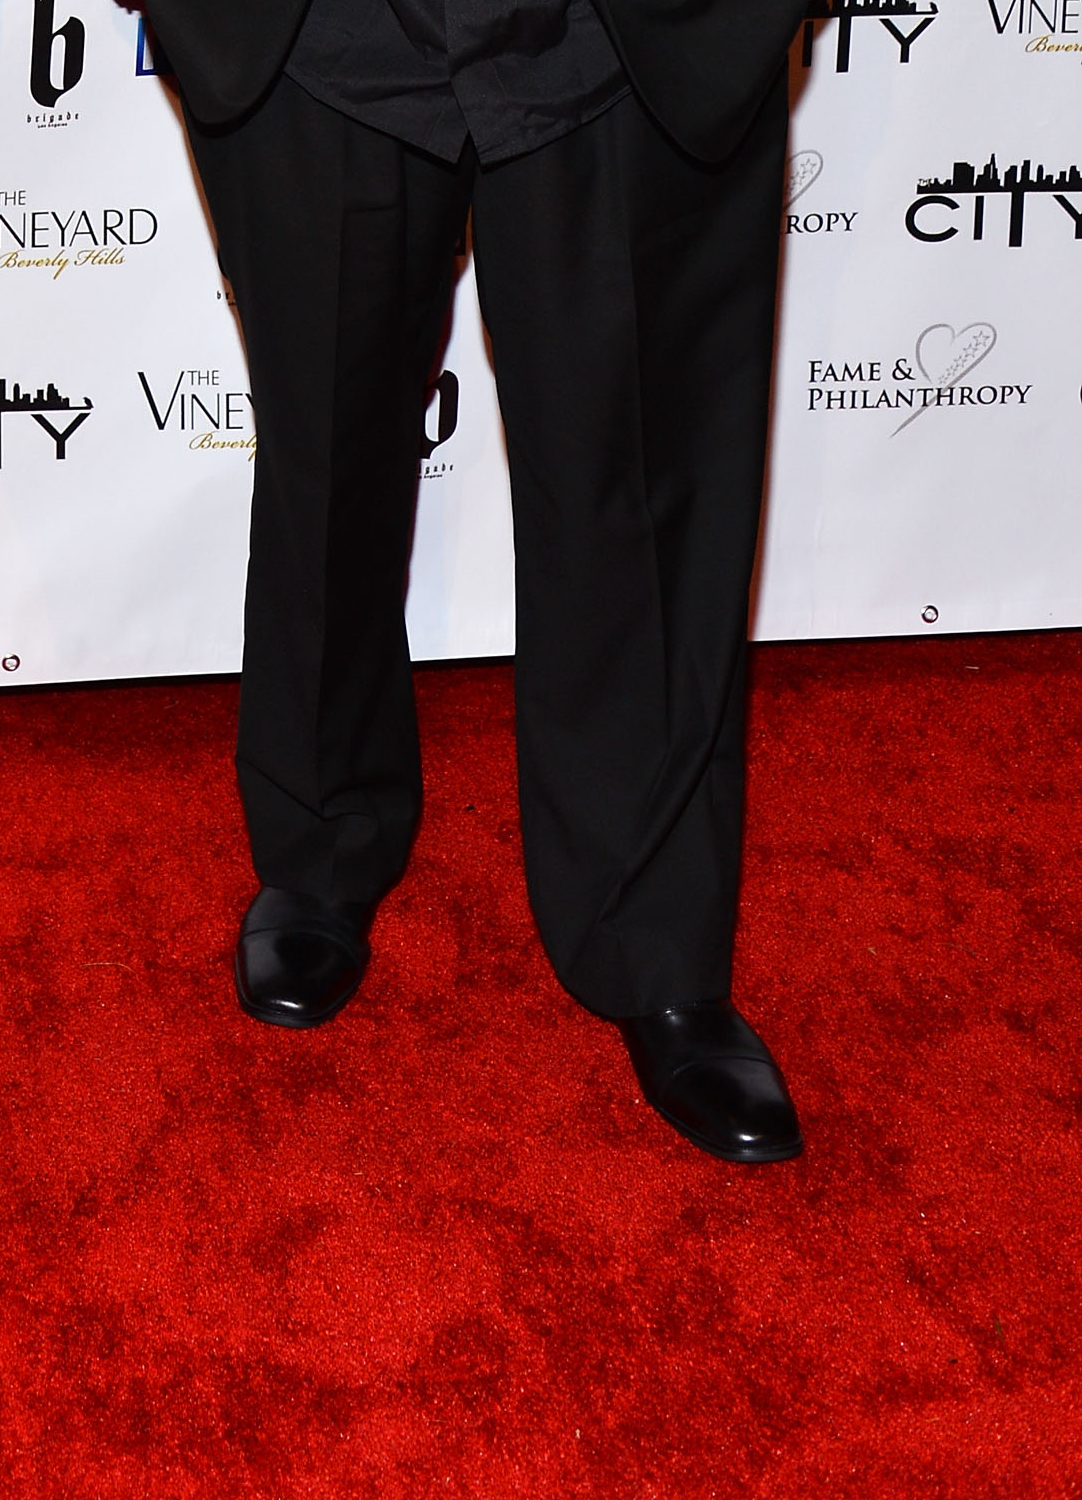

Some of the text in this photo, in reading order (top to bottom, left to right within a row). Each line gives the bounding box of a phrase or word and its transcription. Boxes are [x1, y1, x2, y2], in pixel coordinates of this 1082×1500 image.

[802, 17, 935, 73] ITY
[74, 248, 126, 267] Hills
[187, 370, 220, 386] THE
[807, 358, 916, 383] FAME &
[137, 370, 256, 431] VINE
[807, 385, 1032, 411] PHILANTHROPY
